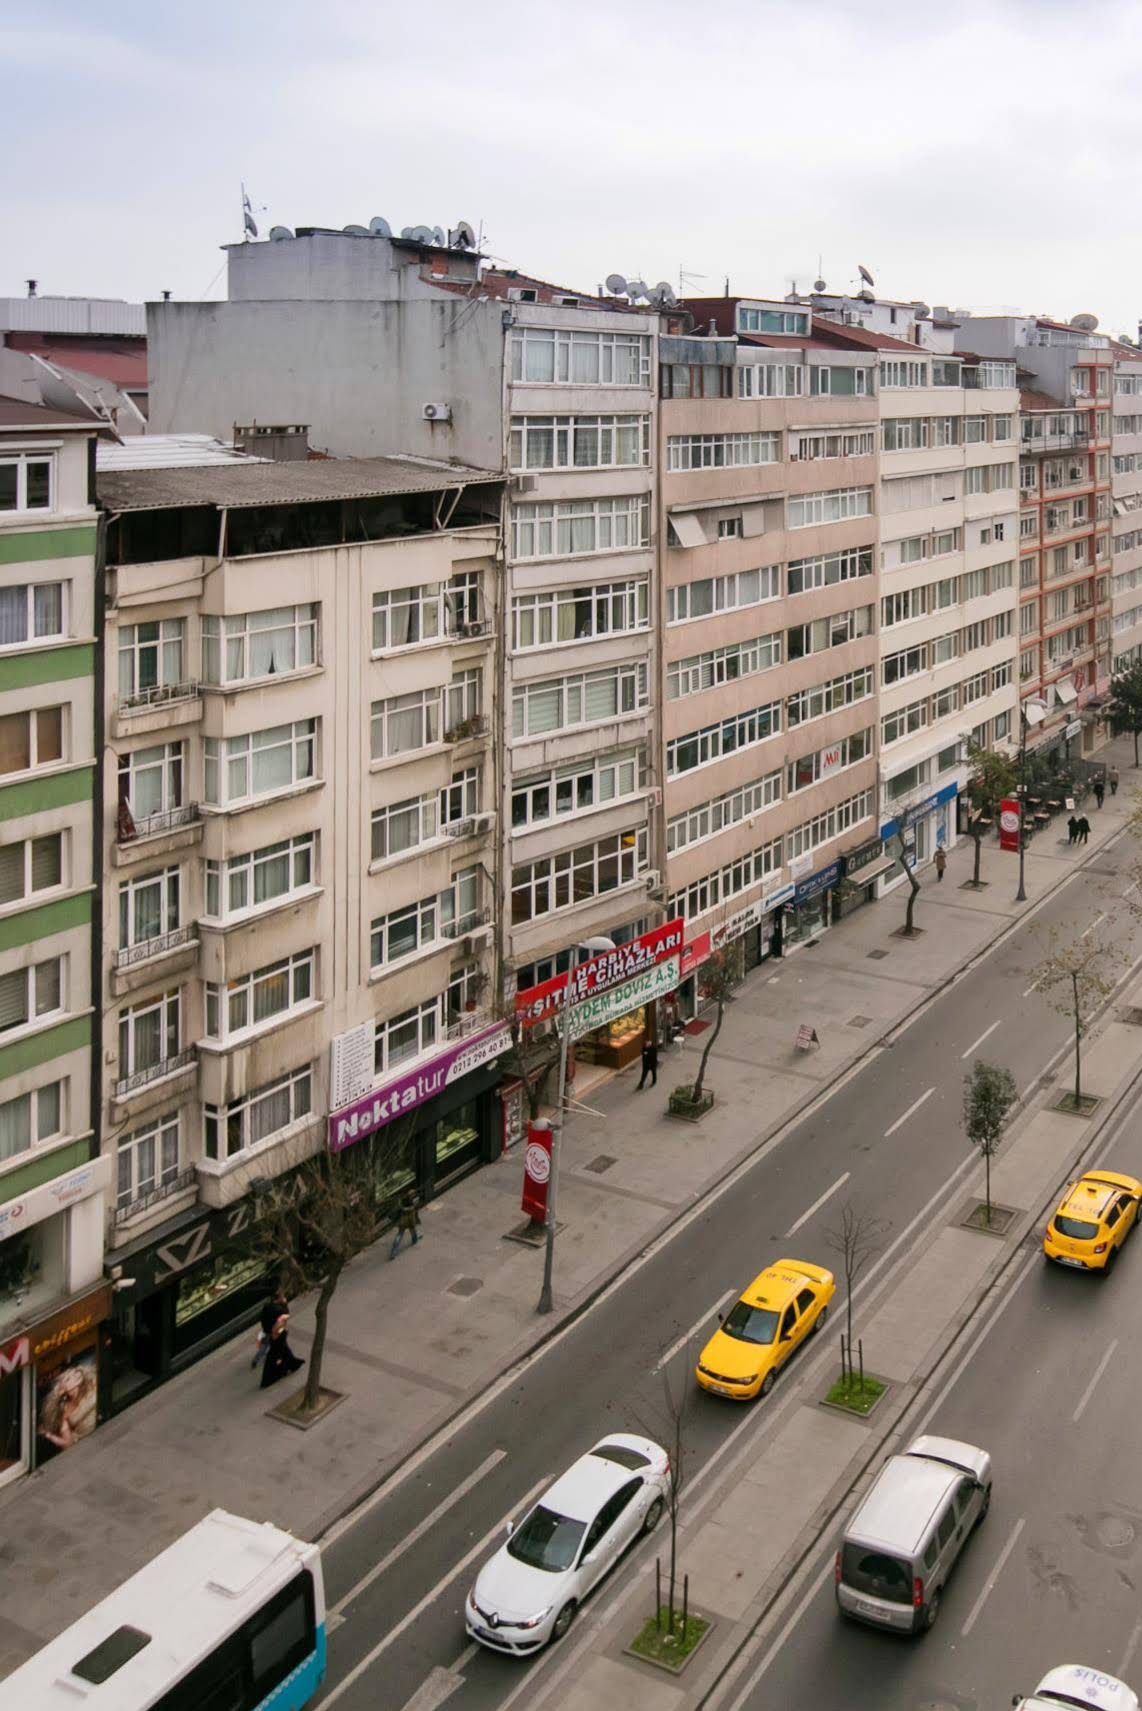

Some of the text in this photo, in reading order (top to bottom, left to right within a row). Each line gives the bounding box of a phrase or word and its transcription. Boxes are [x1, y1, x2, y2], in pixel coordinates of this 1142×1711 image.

[576, 941, 641, 980] HARBİYE
[595, 932, 681, 984] CİHAZLARI
[337, 1068, 444, 1144] Noktatur
